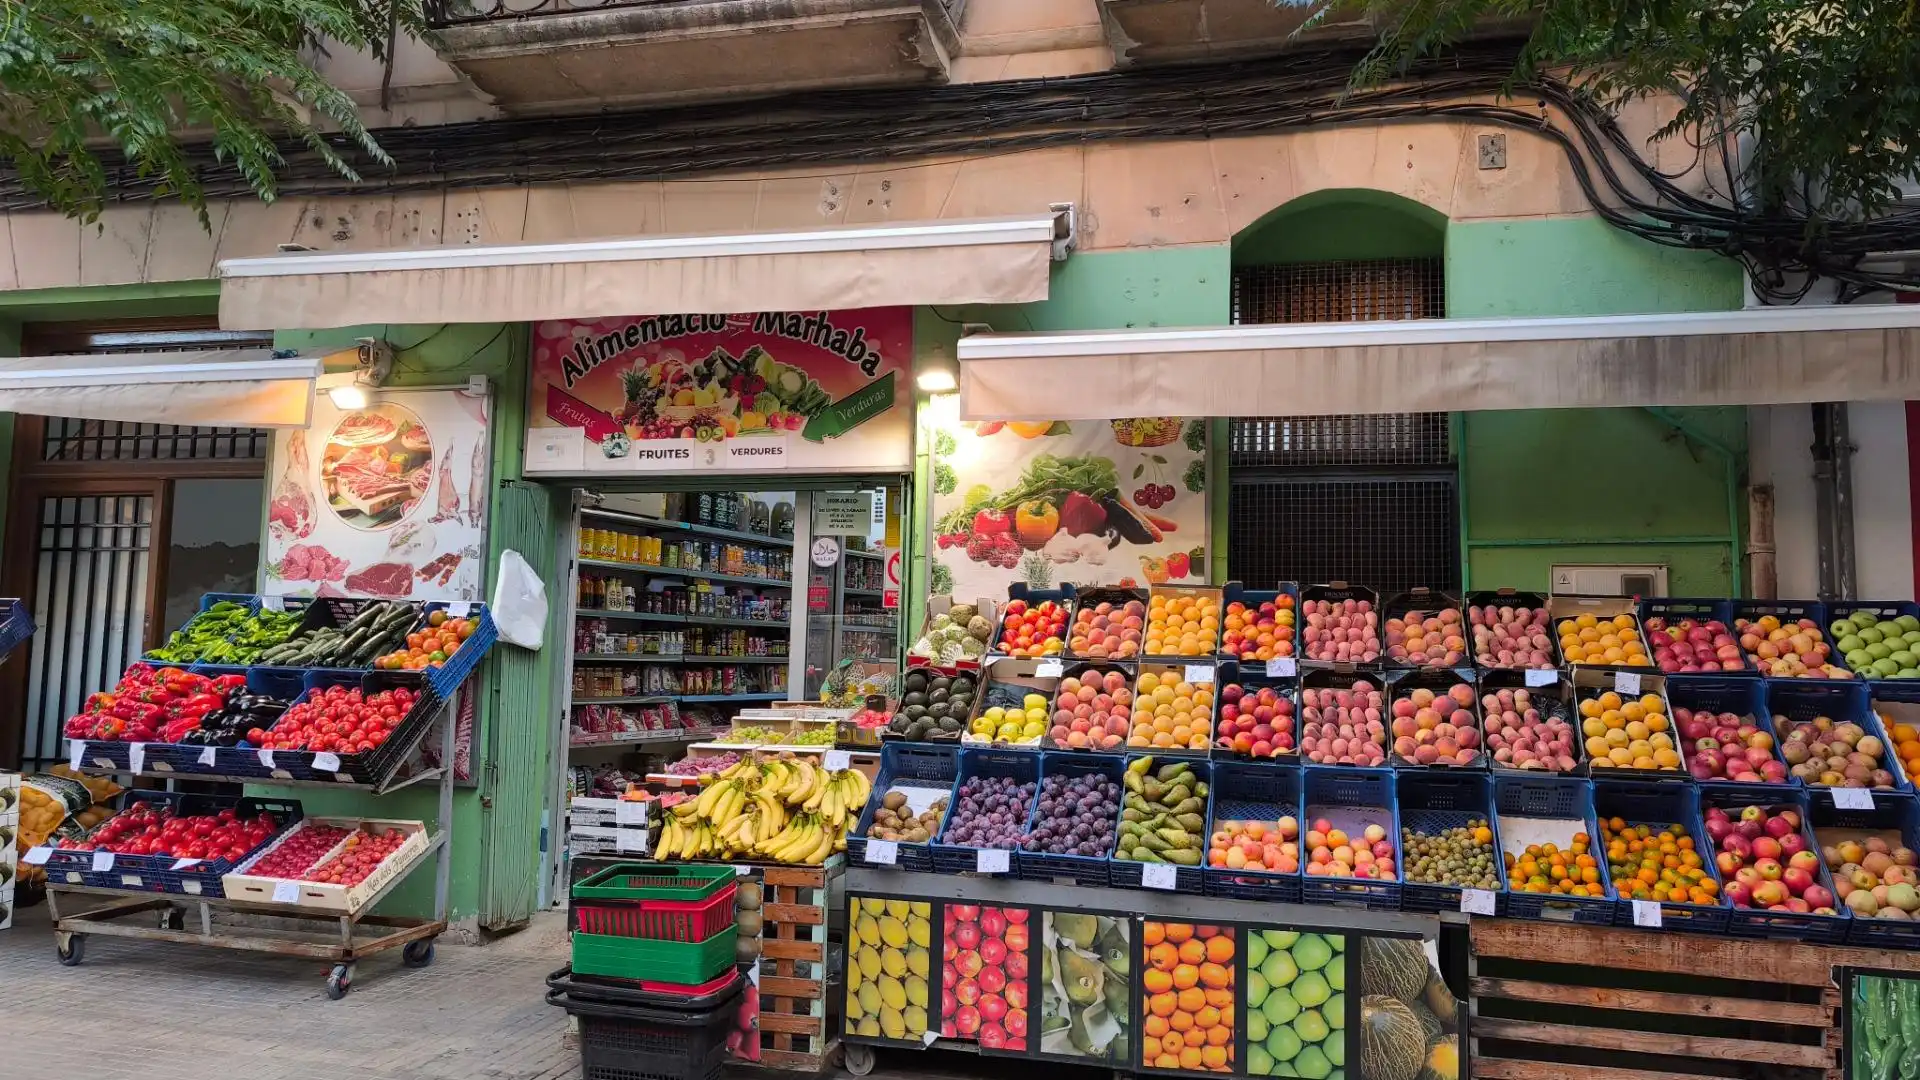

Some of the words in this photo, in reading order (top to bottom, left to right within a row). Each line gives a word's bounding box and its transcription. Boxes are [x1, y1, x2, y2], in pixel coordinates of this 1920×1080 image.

[753, 310, 881, 377] Marhaba
[835, 388, 887, 422] Verduras
[555, 400, 597, 428] Frutas
[638, 448, 689, 460] FRUITES
[705, 449, 715, 465] 3
[730, 446, 783, 457] VERDURES
[813, 541, 837, 556] حلال
